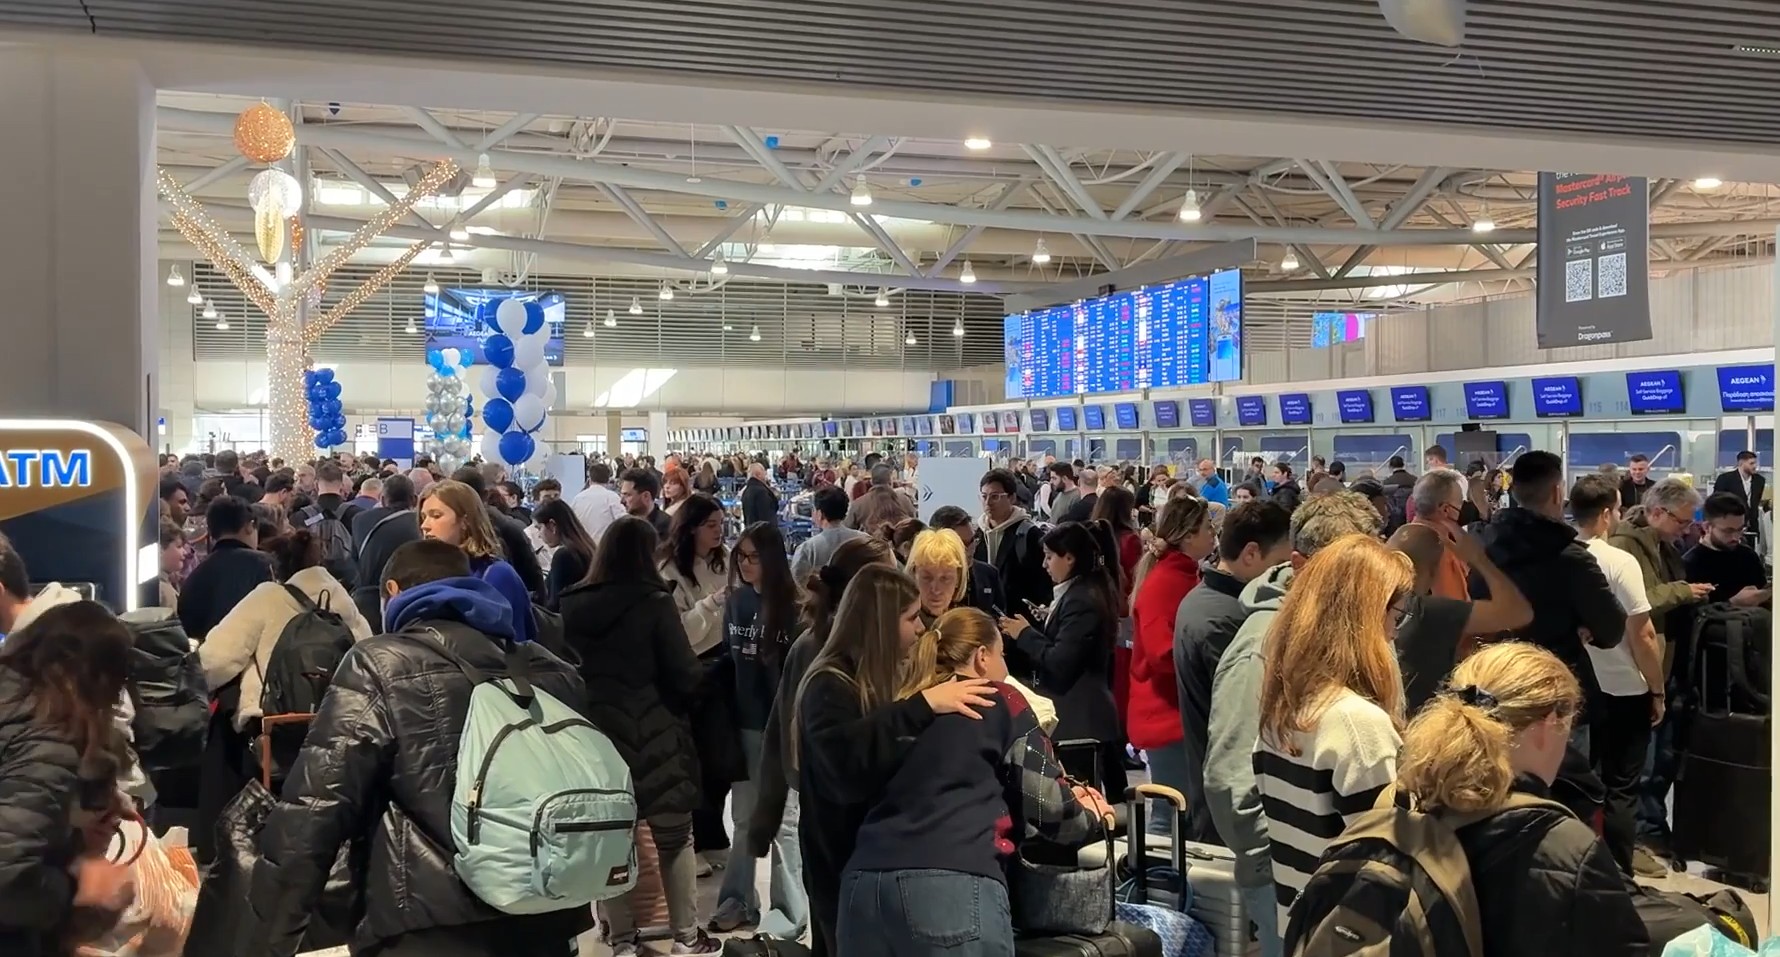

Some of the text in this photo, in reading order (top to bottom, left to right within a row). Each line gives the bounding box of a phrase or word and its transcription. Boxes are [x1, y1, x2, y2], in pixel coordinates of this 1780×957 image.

[1556, 184, 1631, 209] Security Fast Track
[1730, 376, 1760, 384] AEGEAN
[380, 423, 388, 435] B
[0, 449, 91, 488] TM
